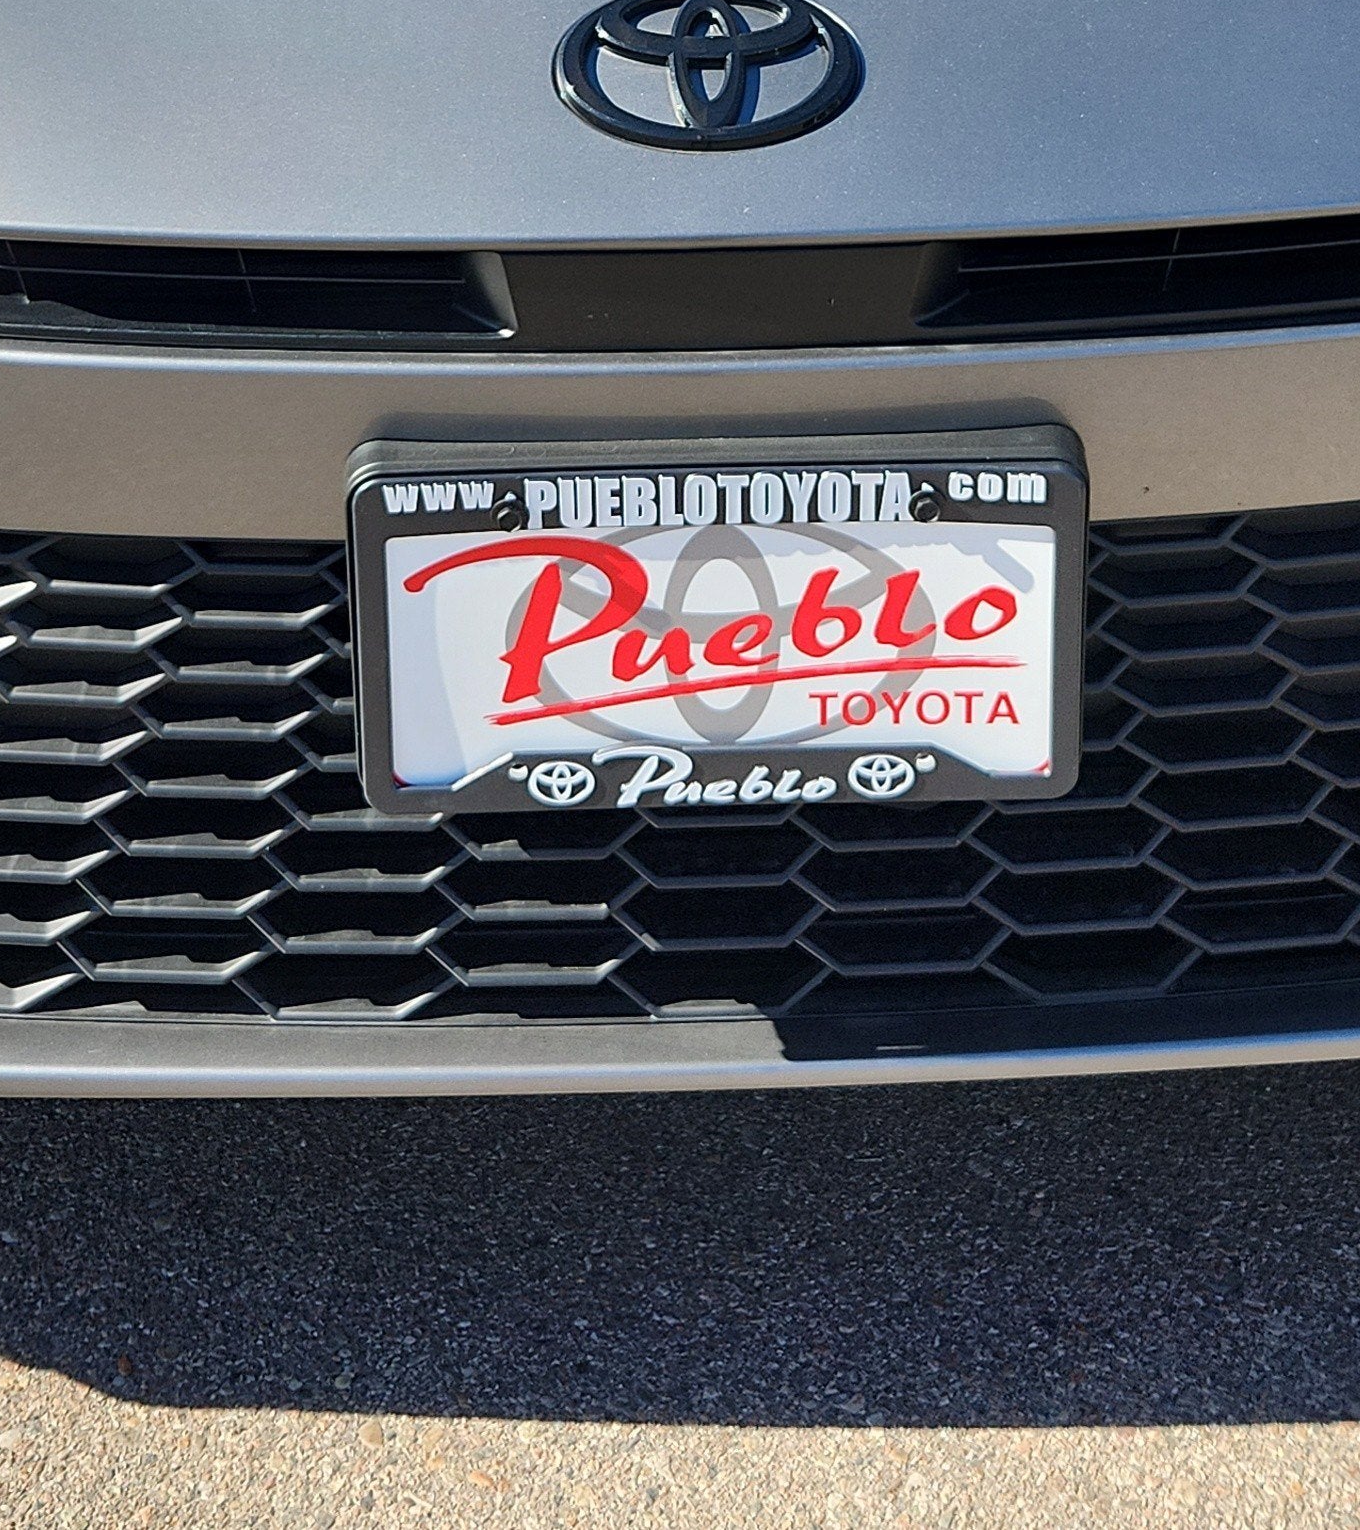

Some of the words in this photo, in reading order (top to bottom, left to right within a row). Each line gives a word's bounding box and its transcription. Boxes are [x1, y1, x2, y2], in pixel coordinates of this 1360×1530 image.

[403, 534, 1019, 704] Pueblo
[808, 689, 1021, 727] TOYOTA
[593, 745, 837, 808] Pueblo
